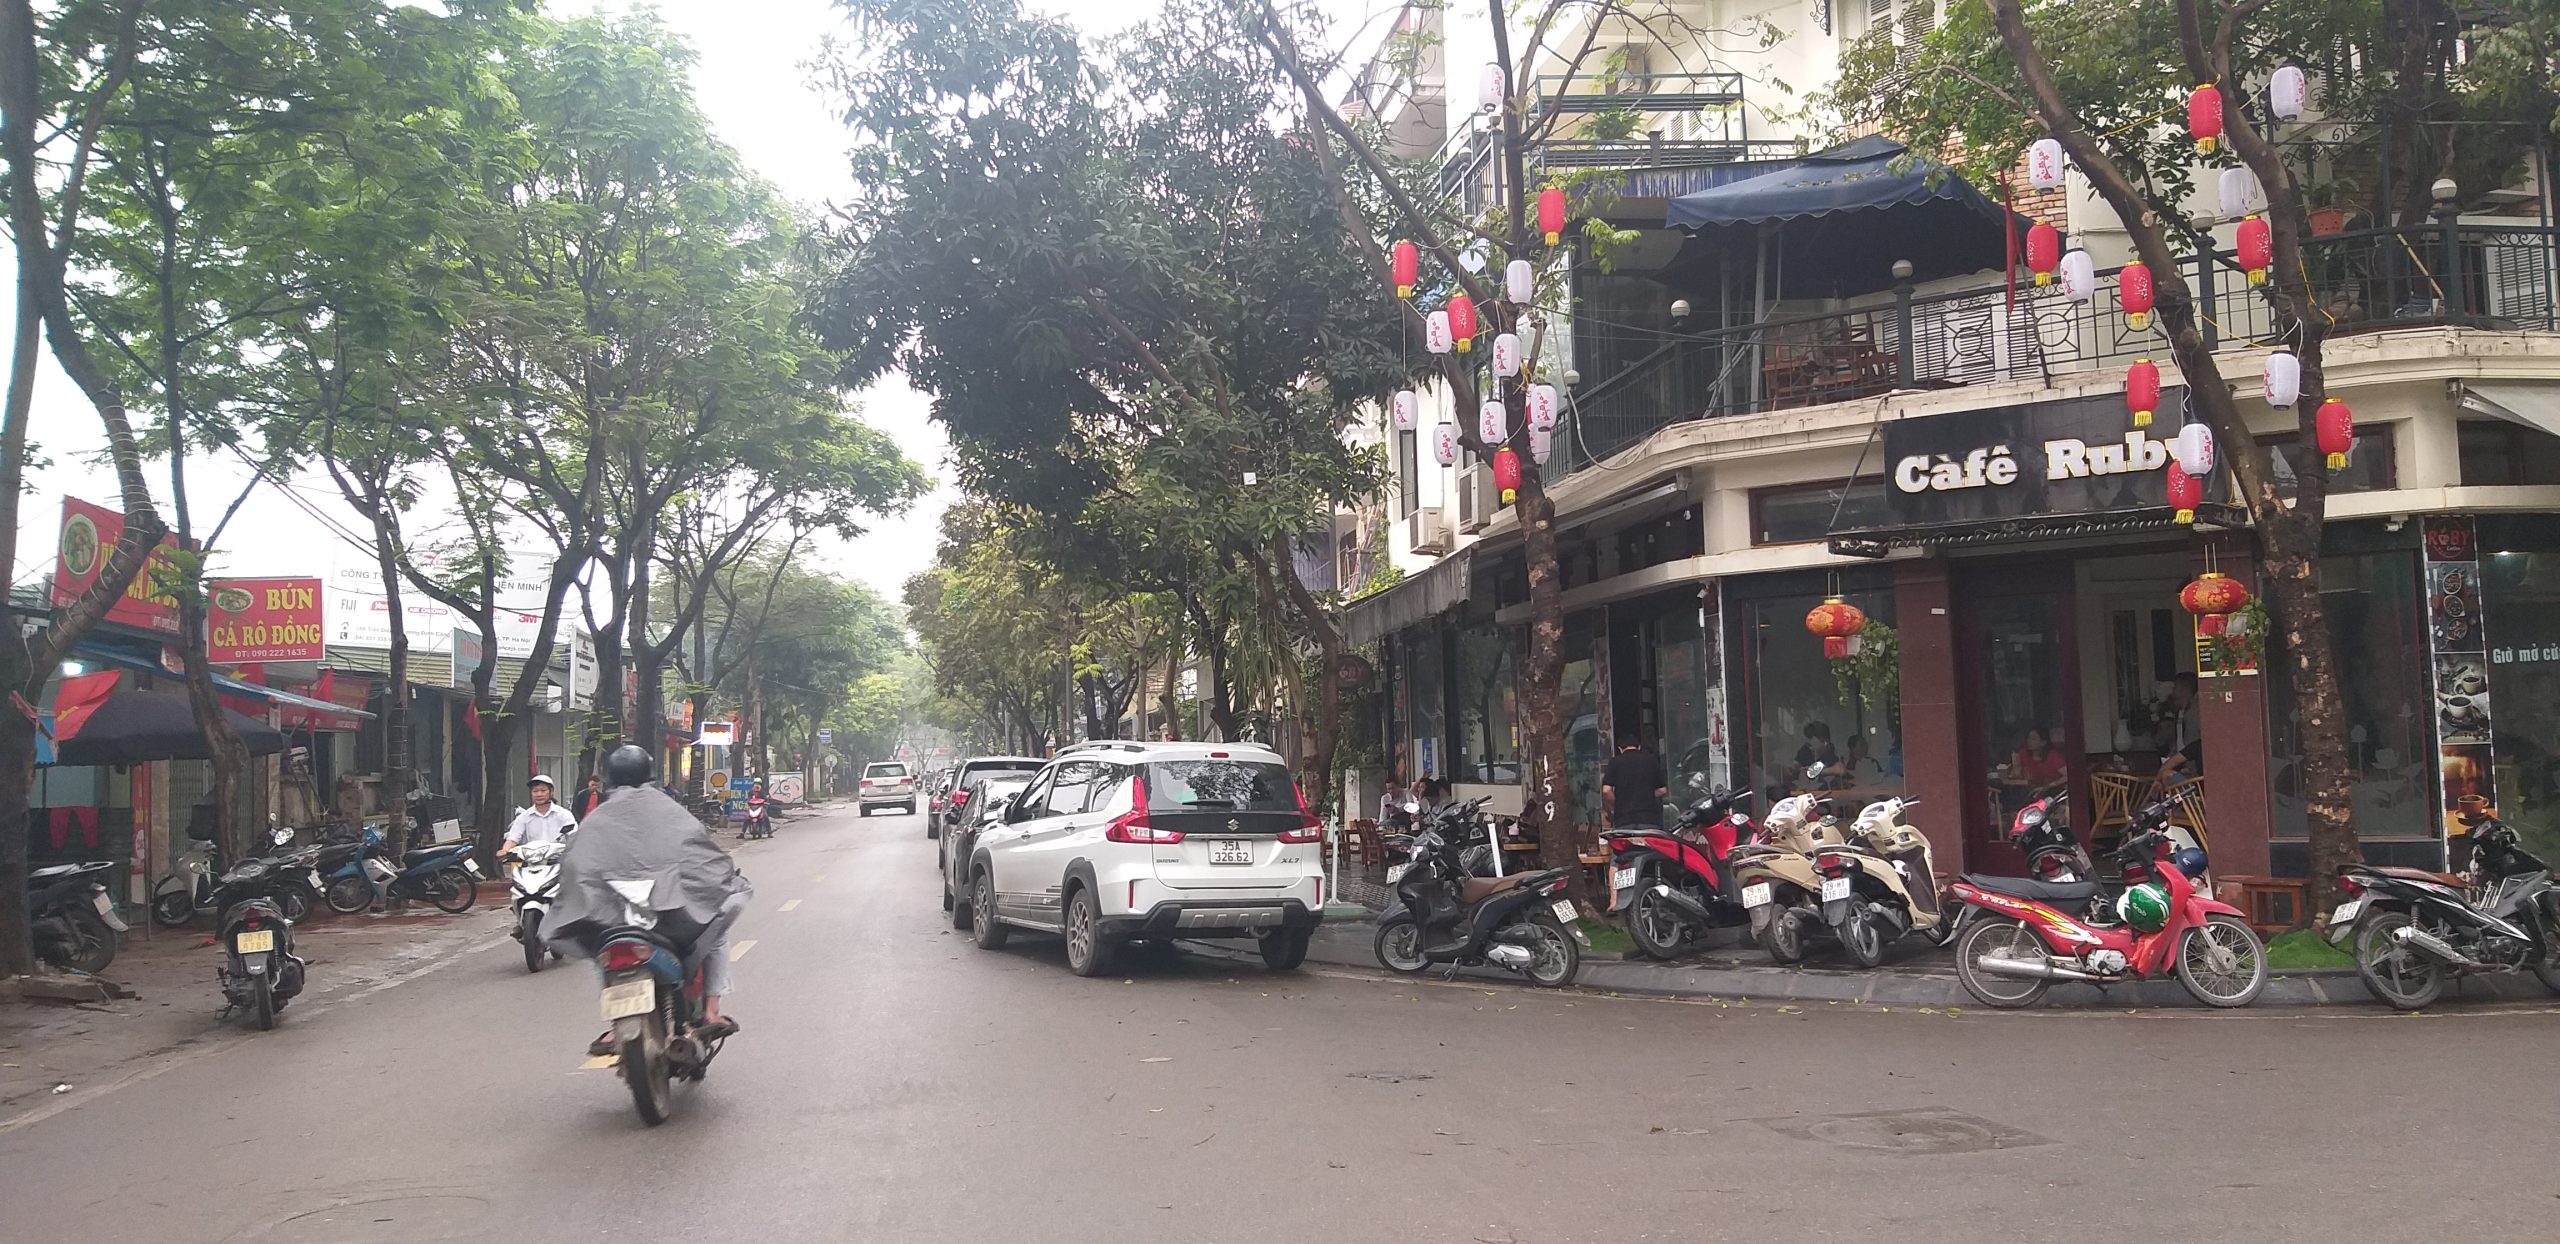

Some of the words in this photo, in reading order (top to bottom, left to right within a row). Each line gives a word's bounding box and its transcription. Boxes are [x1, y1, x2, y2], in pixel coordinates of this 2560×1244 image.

[1895, 445, 2018, 493] Càfê
[341, 568, 370, 578] CÔNG
[517, 582, 542, 592] MINH
[266, 582, 313, 610] BÚN
[341, 599, 357, 611] FIJI
[518, 614, 537, 623] 3M
[213, 620, 238, 647] CÁ
[242, 619, 267, 647] RÔ
[271, 614, 321, 645] ĐỒNG
[252, 649, 267, 657] 090
[287, 648, 307, 656] 1635
[2519, 643, 2539, 662] mở
[2543, 643, 2560, 661] cử
[1221, 841, 1241, 851] 35A
[1214, 852, 1249, 862] 326.62
